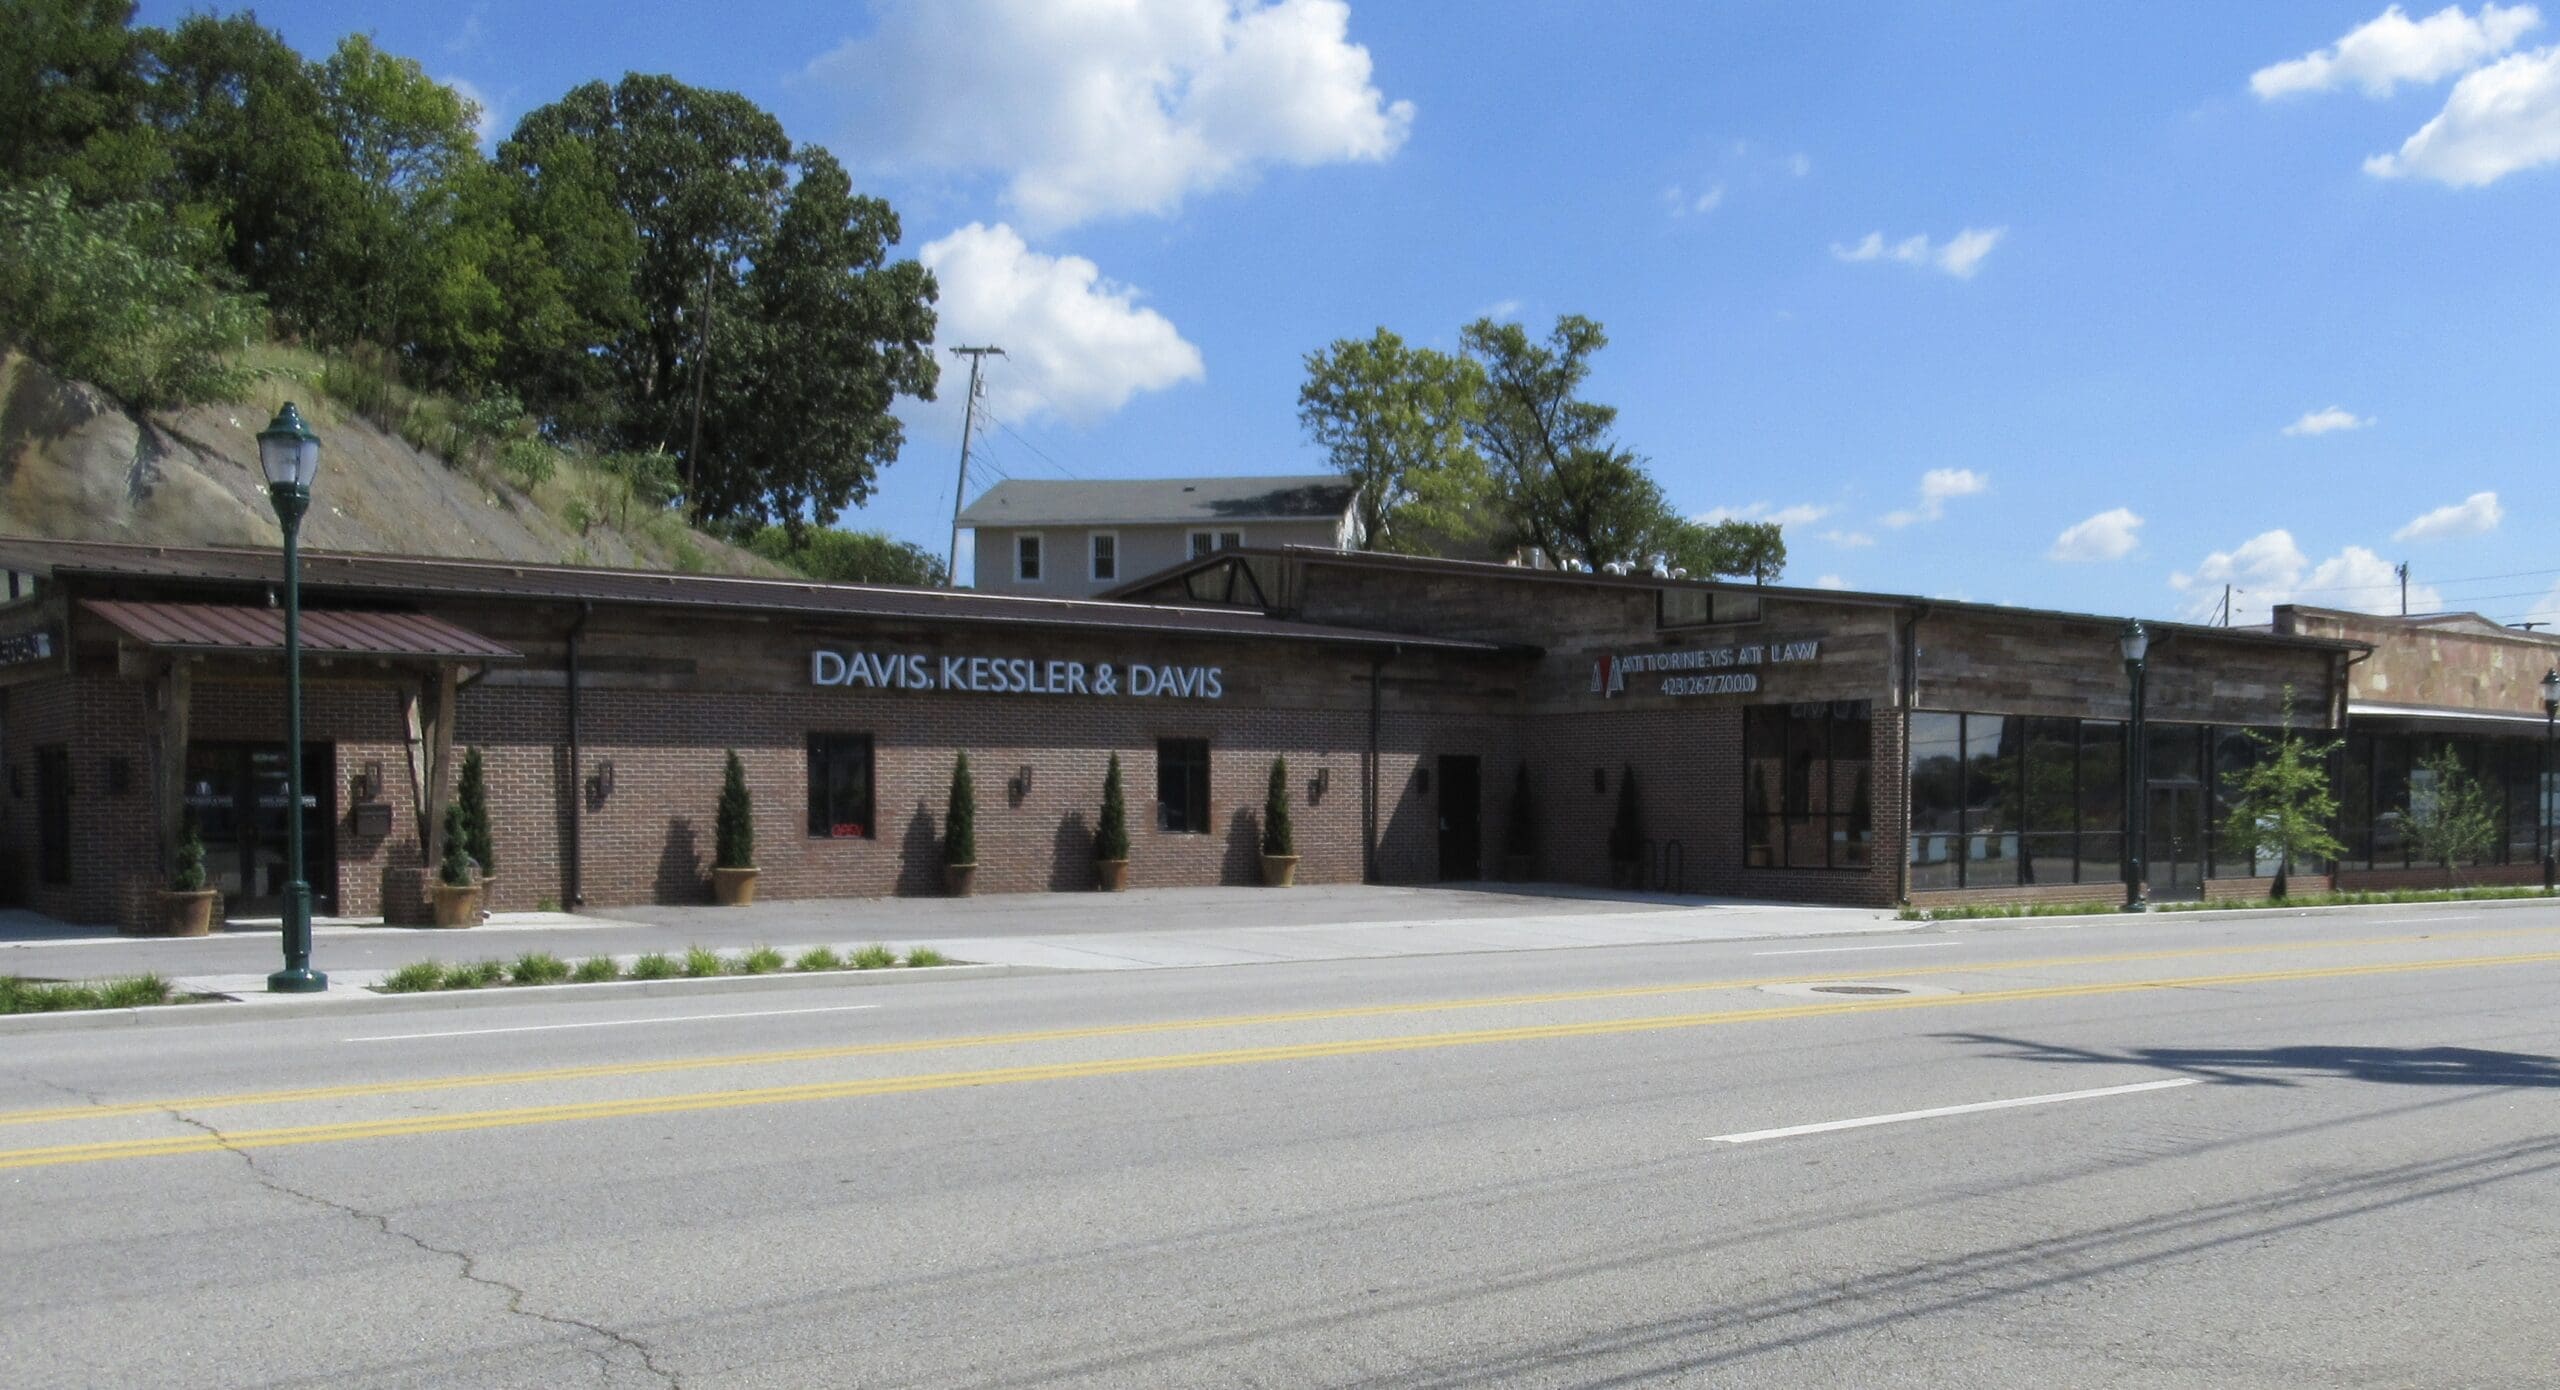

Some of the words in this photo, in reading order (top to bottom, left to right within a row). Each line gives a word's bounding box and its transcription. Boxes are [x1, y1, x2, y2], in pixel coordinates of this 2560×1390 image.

[1620, 648, 1735, 673] ATTORNEYS
[1738, 645, 1764, 664] AT
[1771, 641, 1818, 663] LAW
[939, 656, 1089, 693] KESSLER
[1094, 664, 1117, 694] &
[1127, 664, 1223, 698] DAVIS
